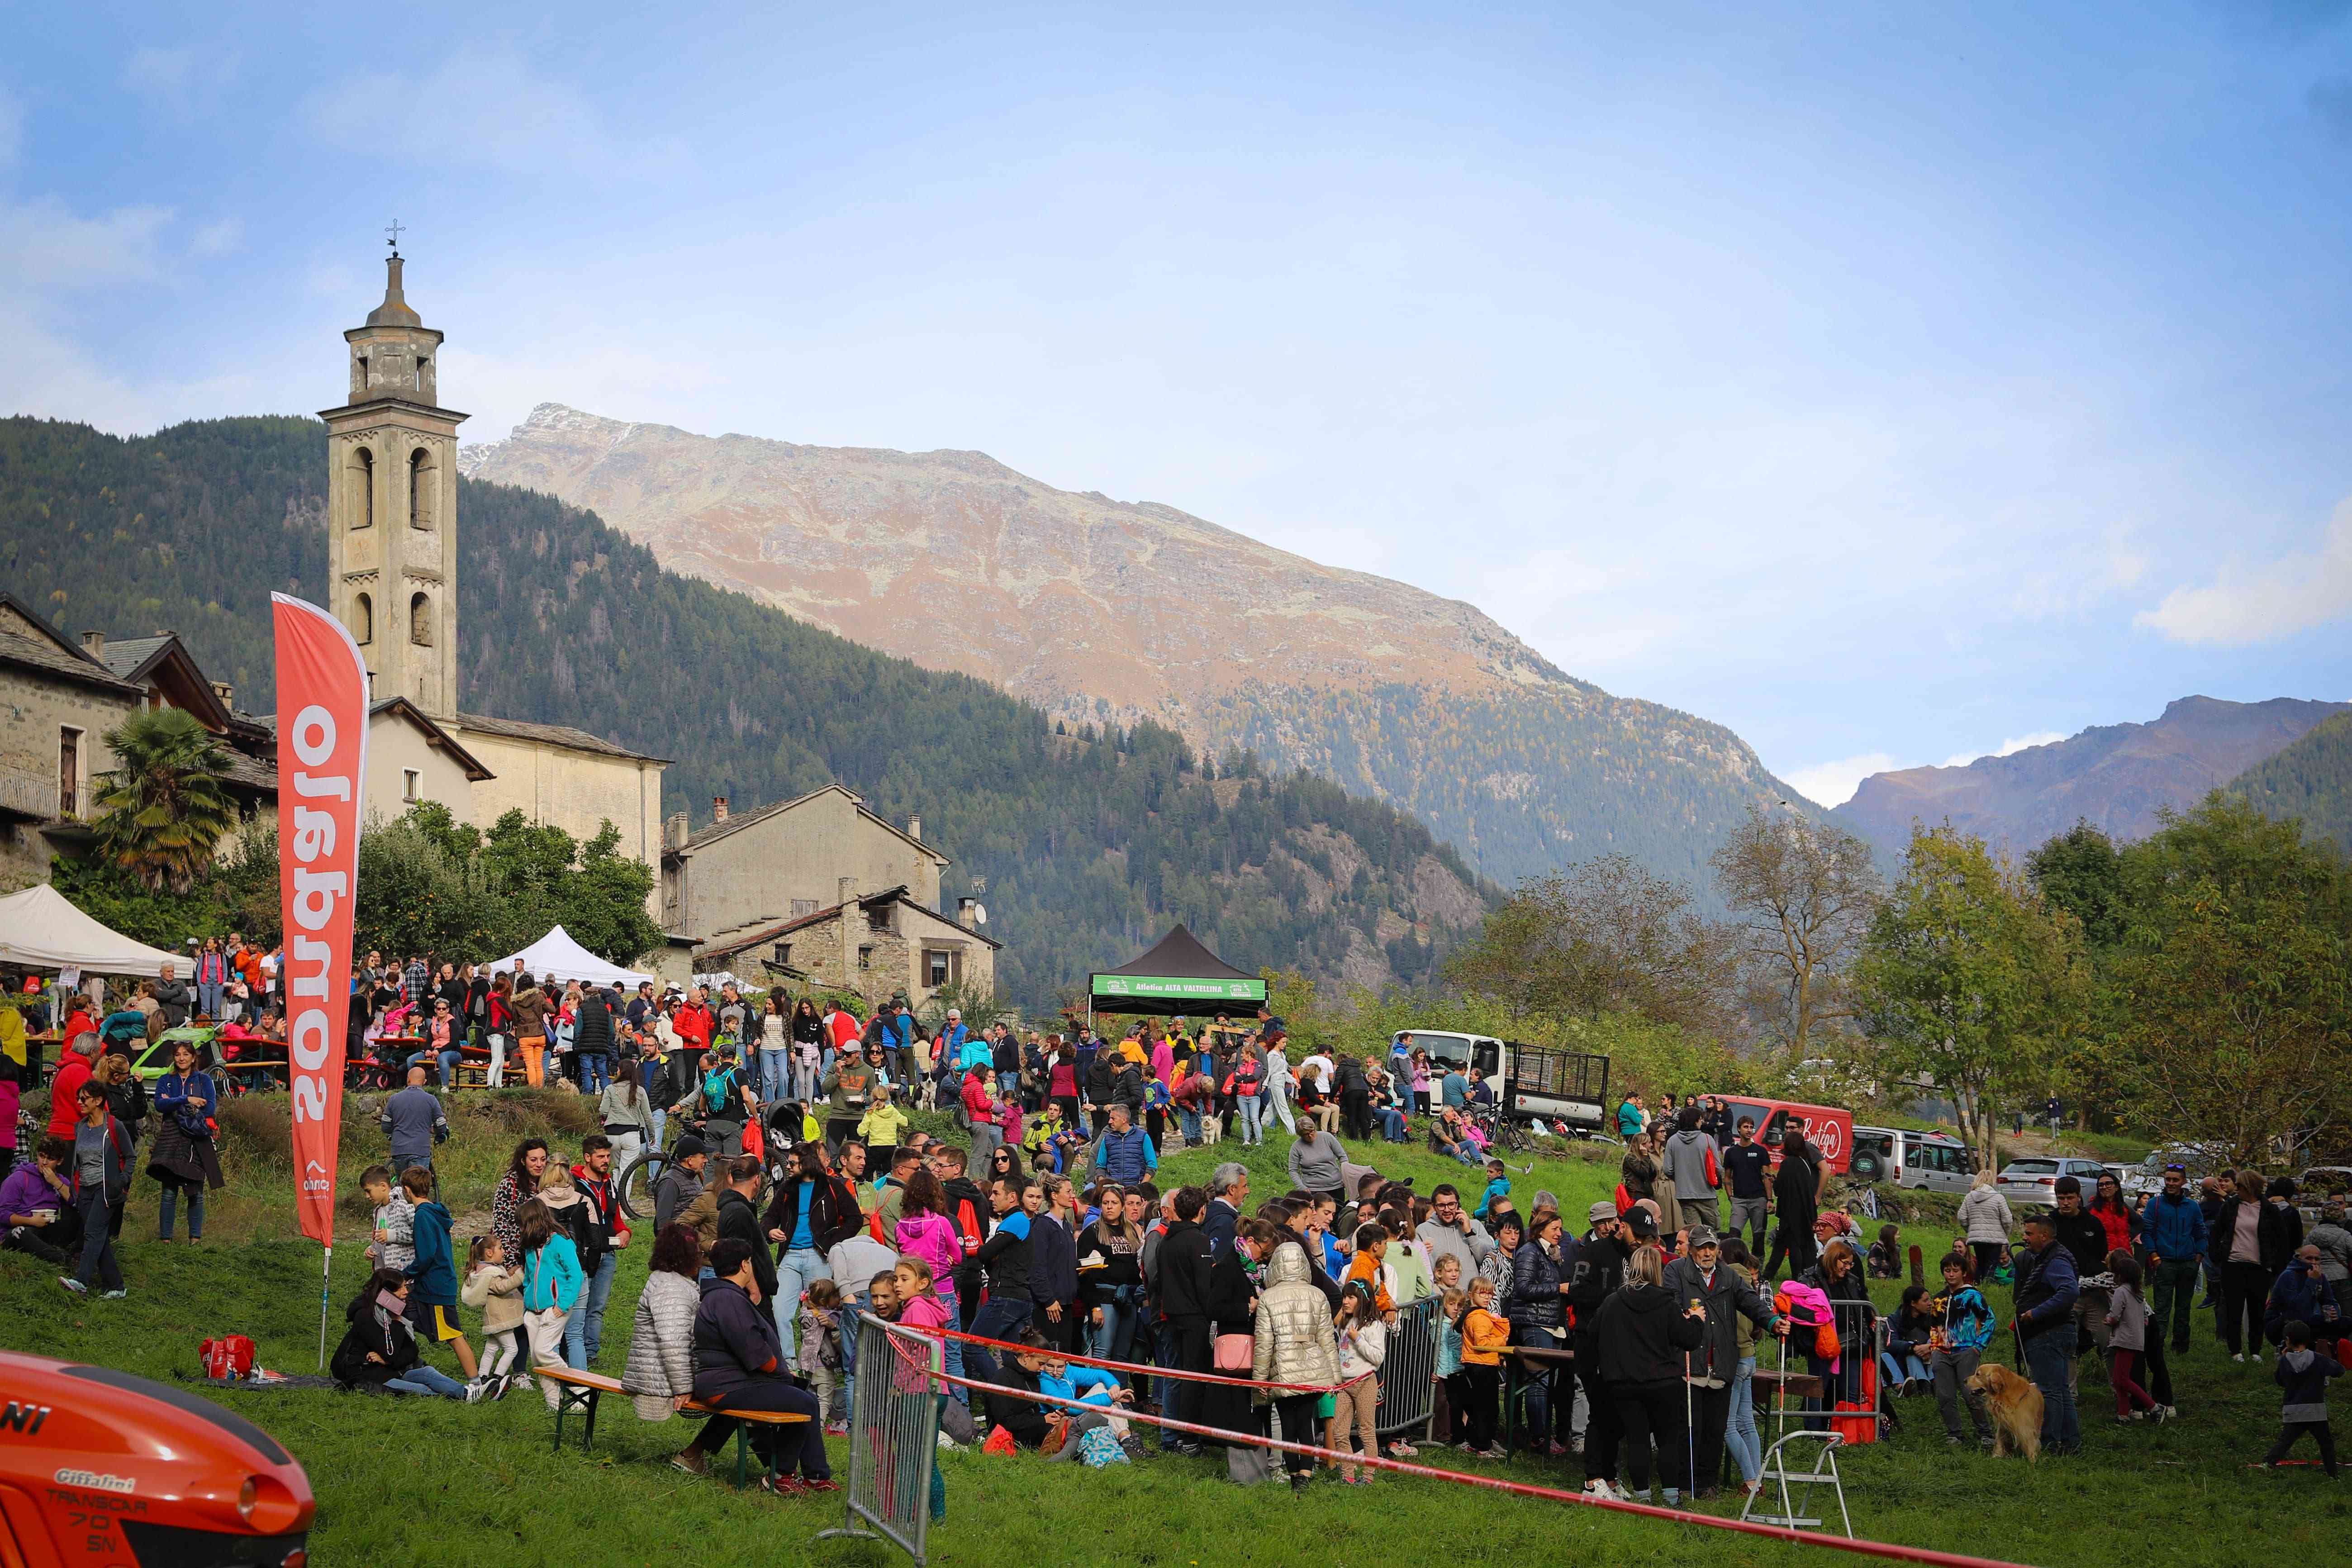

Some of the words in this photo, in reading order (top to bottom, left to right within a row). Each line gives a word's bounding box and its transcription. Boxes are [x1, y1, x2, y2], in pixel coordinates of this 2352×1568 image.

[0, 1401, 52, 1435] NI
[45, 1488, 148, 1514] TRANSCAR
[68, 1511, 110, 1530] 70
